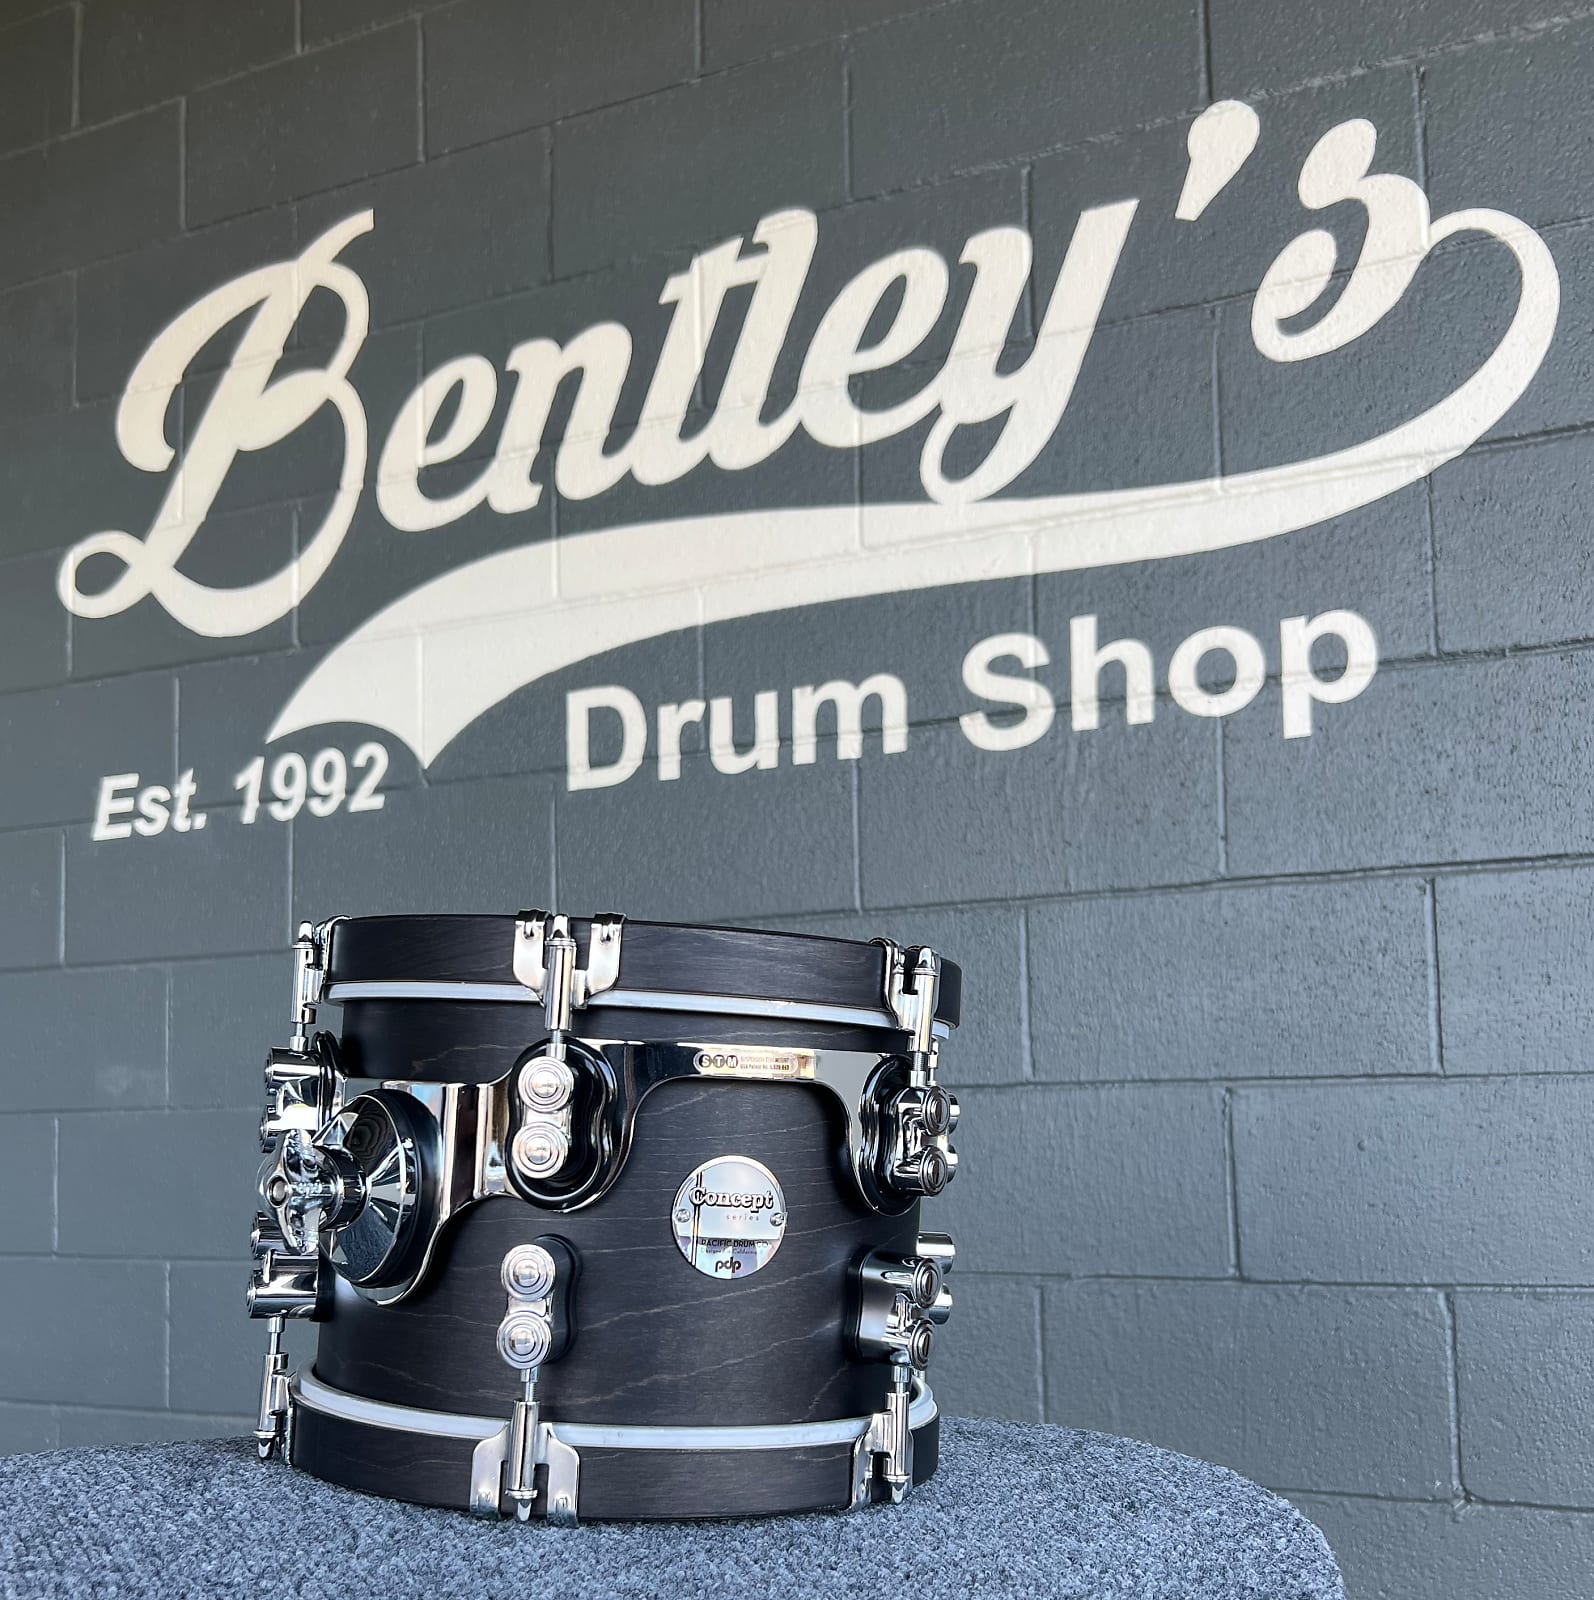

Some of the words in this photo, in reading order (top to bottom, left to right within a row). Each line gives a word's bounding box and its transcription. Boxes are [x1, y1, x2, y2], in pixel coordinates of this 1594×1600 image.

[58, 100, 1560, 640] Bentley's
[566, 672, 908, 791] Drum
[958, 609, 1380, 751] Shop
[92, 768, 207, 841] Est.
[234, 741, 389, 825] 1992
[699, 1054, 739, 1069] STM
[689, 1187, 774, 1214] Concept
[726, 1213, 760, 1221] series
[733, 1240, 755, 1248] DRUM
[714, 1256, 742, 1274] pdp
